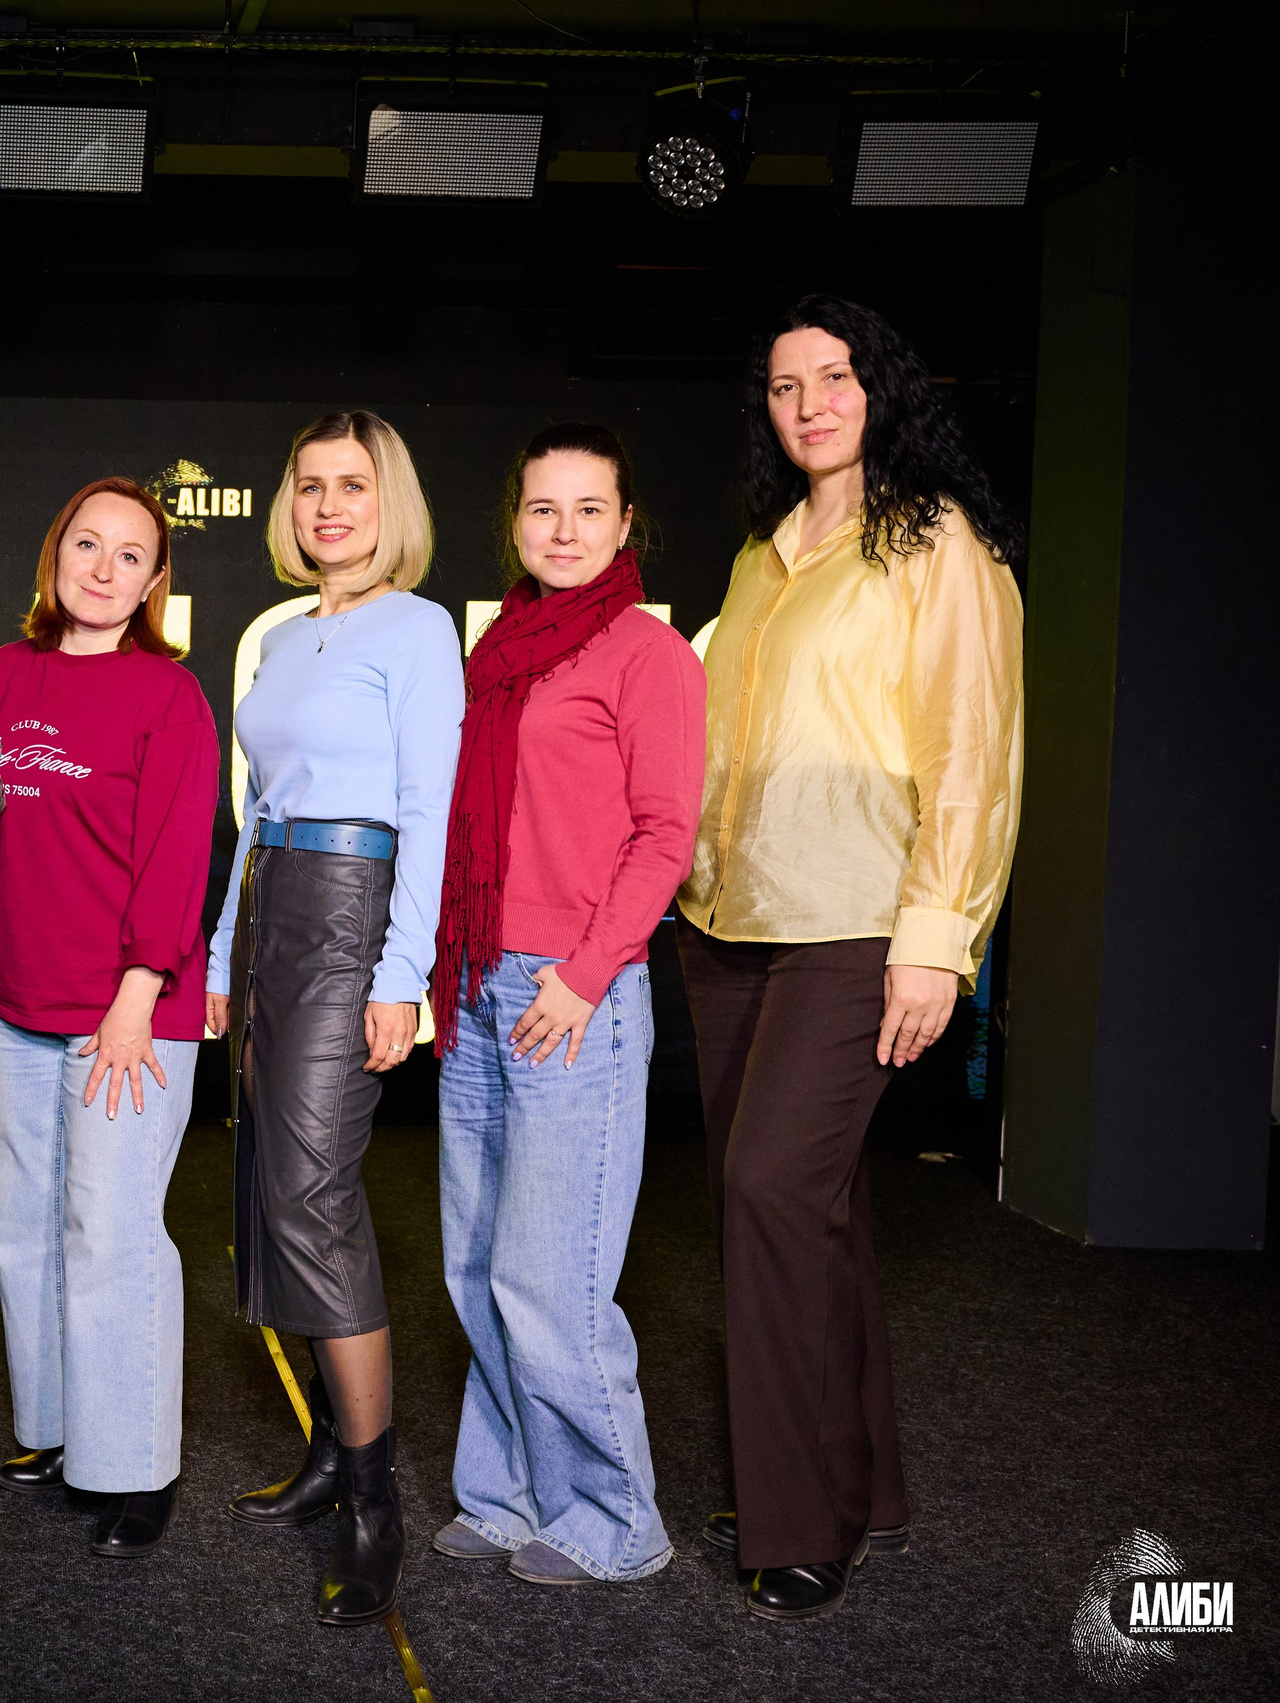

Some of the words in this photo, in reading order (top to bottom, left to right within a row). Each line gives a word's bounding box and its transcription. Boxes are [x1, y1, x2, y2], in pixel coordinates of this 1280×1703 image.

[11, 720, 41, 732] CLUB
[40, 724, 60, 736] 1987
[12, 785, 41, 797] 75004
